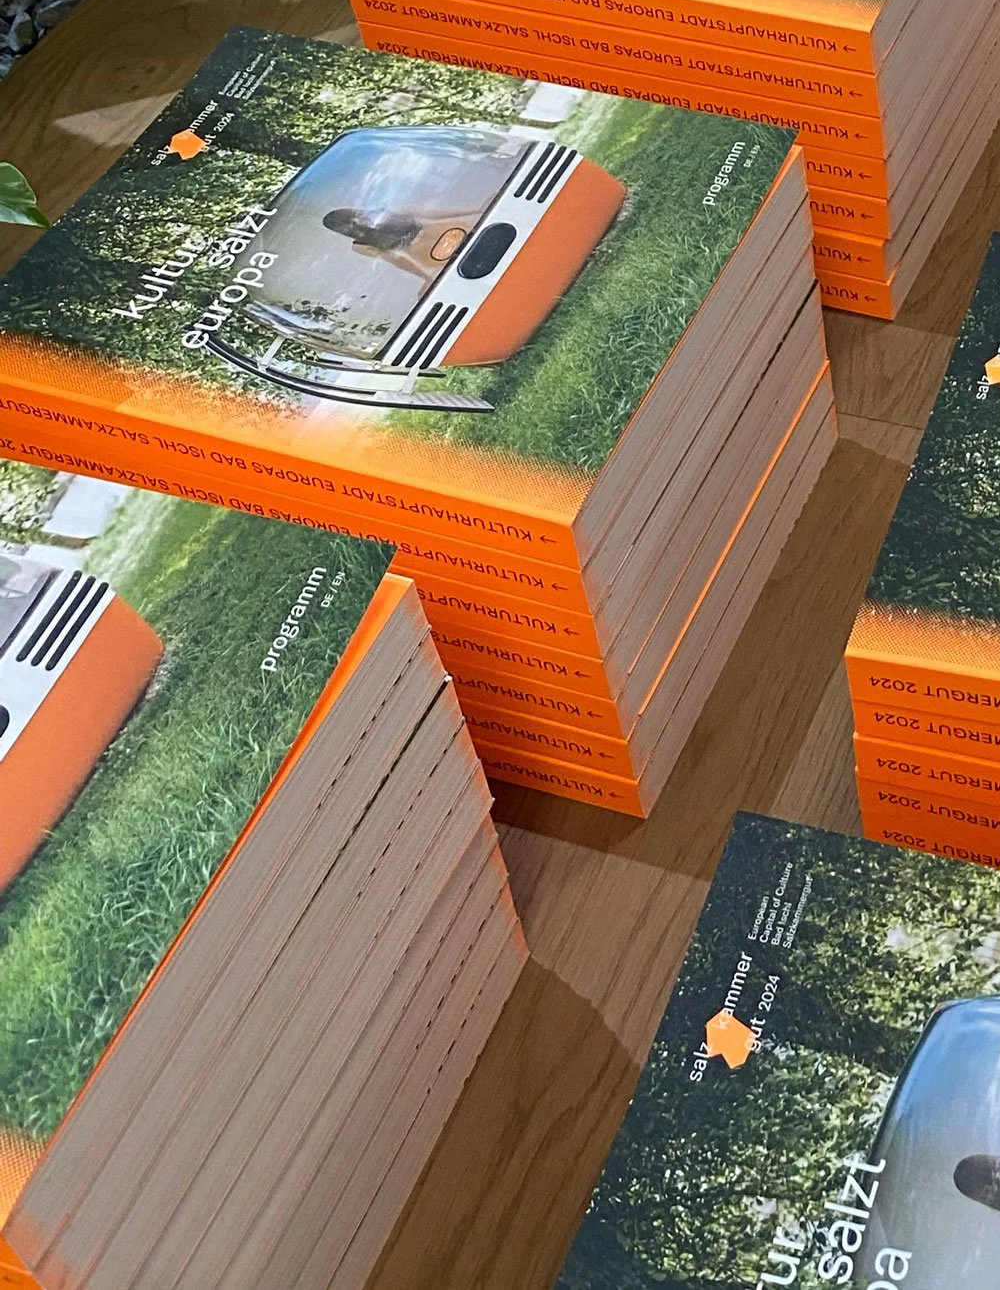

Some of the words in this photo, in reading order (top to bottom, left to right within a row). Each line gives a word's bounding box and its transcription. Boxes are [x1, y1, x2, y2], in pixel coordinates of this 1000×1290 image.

[364, 0, 397, 13] 2024
[402, 6, 529, 37] SALZKAMMERGUT
[604, 0, 674, 21] EUROPAS
[377, 41, 409, 56] 2024
[532, 29, 575, 46] ISCHL
[579, 38, 610, 53] BAD
[679, 14, 836, 51] KULTURHAUPTSTADT
[414, 48, 538, 79] SALZKAMMERGUT
[613, 44, 682, 66] EUROPAS
[541, 72, 585, 88] ISCHL
[589, 81, 618, 95] BAD
[687, 59, 842, 96] KULTURHAUPTSTADT
[622, 87, 691, 108] EUROPAS
[189, 100, 219, 133] ammer
[213, 112, 235, 133] 2024
[695, 101, 848, 138] KULTURHAUPTSTADT
[702, 140, 746, 206] programm
[209, 206, 277, 269] salzt
[110, 237, 199, 319] kultur
[181, 251, 279, 348] europa
[0, 400, 149, 444] SALZKAMMERGUT
[153, 436, 205, 459] ISCHL
[210, 451, 246, 469] BAD
[21, 445, 168, 491] SALZKAMMERGUT
[251, 461, 335, 492] EUROPAS
[171, 483, 224, 506] ISCHL
[229, 498, 265, 516] BAD
[342, 484, 531, 541] KULTURHAUPTSTADT
[321, 592, 333, 609] DE
[333, 570, 346, 586] EN
[260, 566, 327, 672] programm
[416, 588, 556, 633] KULTURHAUPTS
[430, 630, 567, 674] KULTURHAUPTS
[456, 673, 580, 715] KULTURHAUPT
[870, 676, 917, 693] 2024
[465, 714, 592, 755] KULTURHAUPT
[874, 711, 920, 729] 2024
[876, 757, 921, 775] 2024
[878, 791, 921, 810] 2024
[882, 830, 925, 848] 2024
[748, 895, 769, 940] European
[760, 908, 778, 943] Capital
[775, 862, 793, 896] Culture
[783, 873, 814, 948] Salzkammergut
[771, 927, 783, 946] Bad
[779, 902, 792, 927] Ischl
[746, 1017, 766, 1052] gut
[758, 975, 780, 1012] 2024
[689, 1041, 713, 1083] salz
[818, 1157, 886, 1284] salzt
